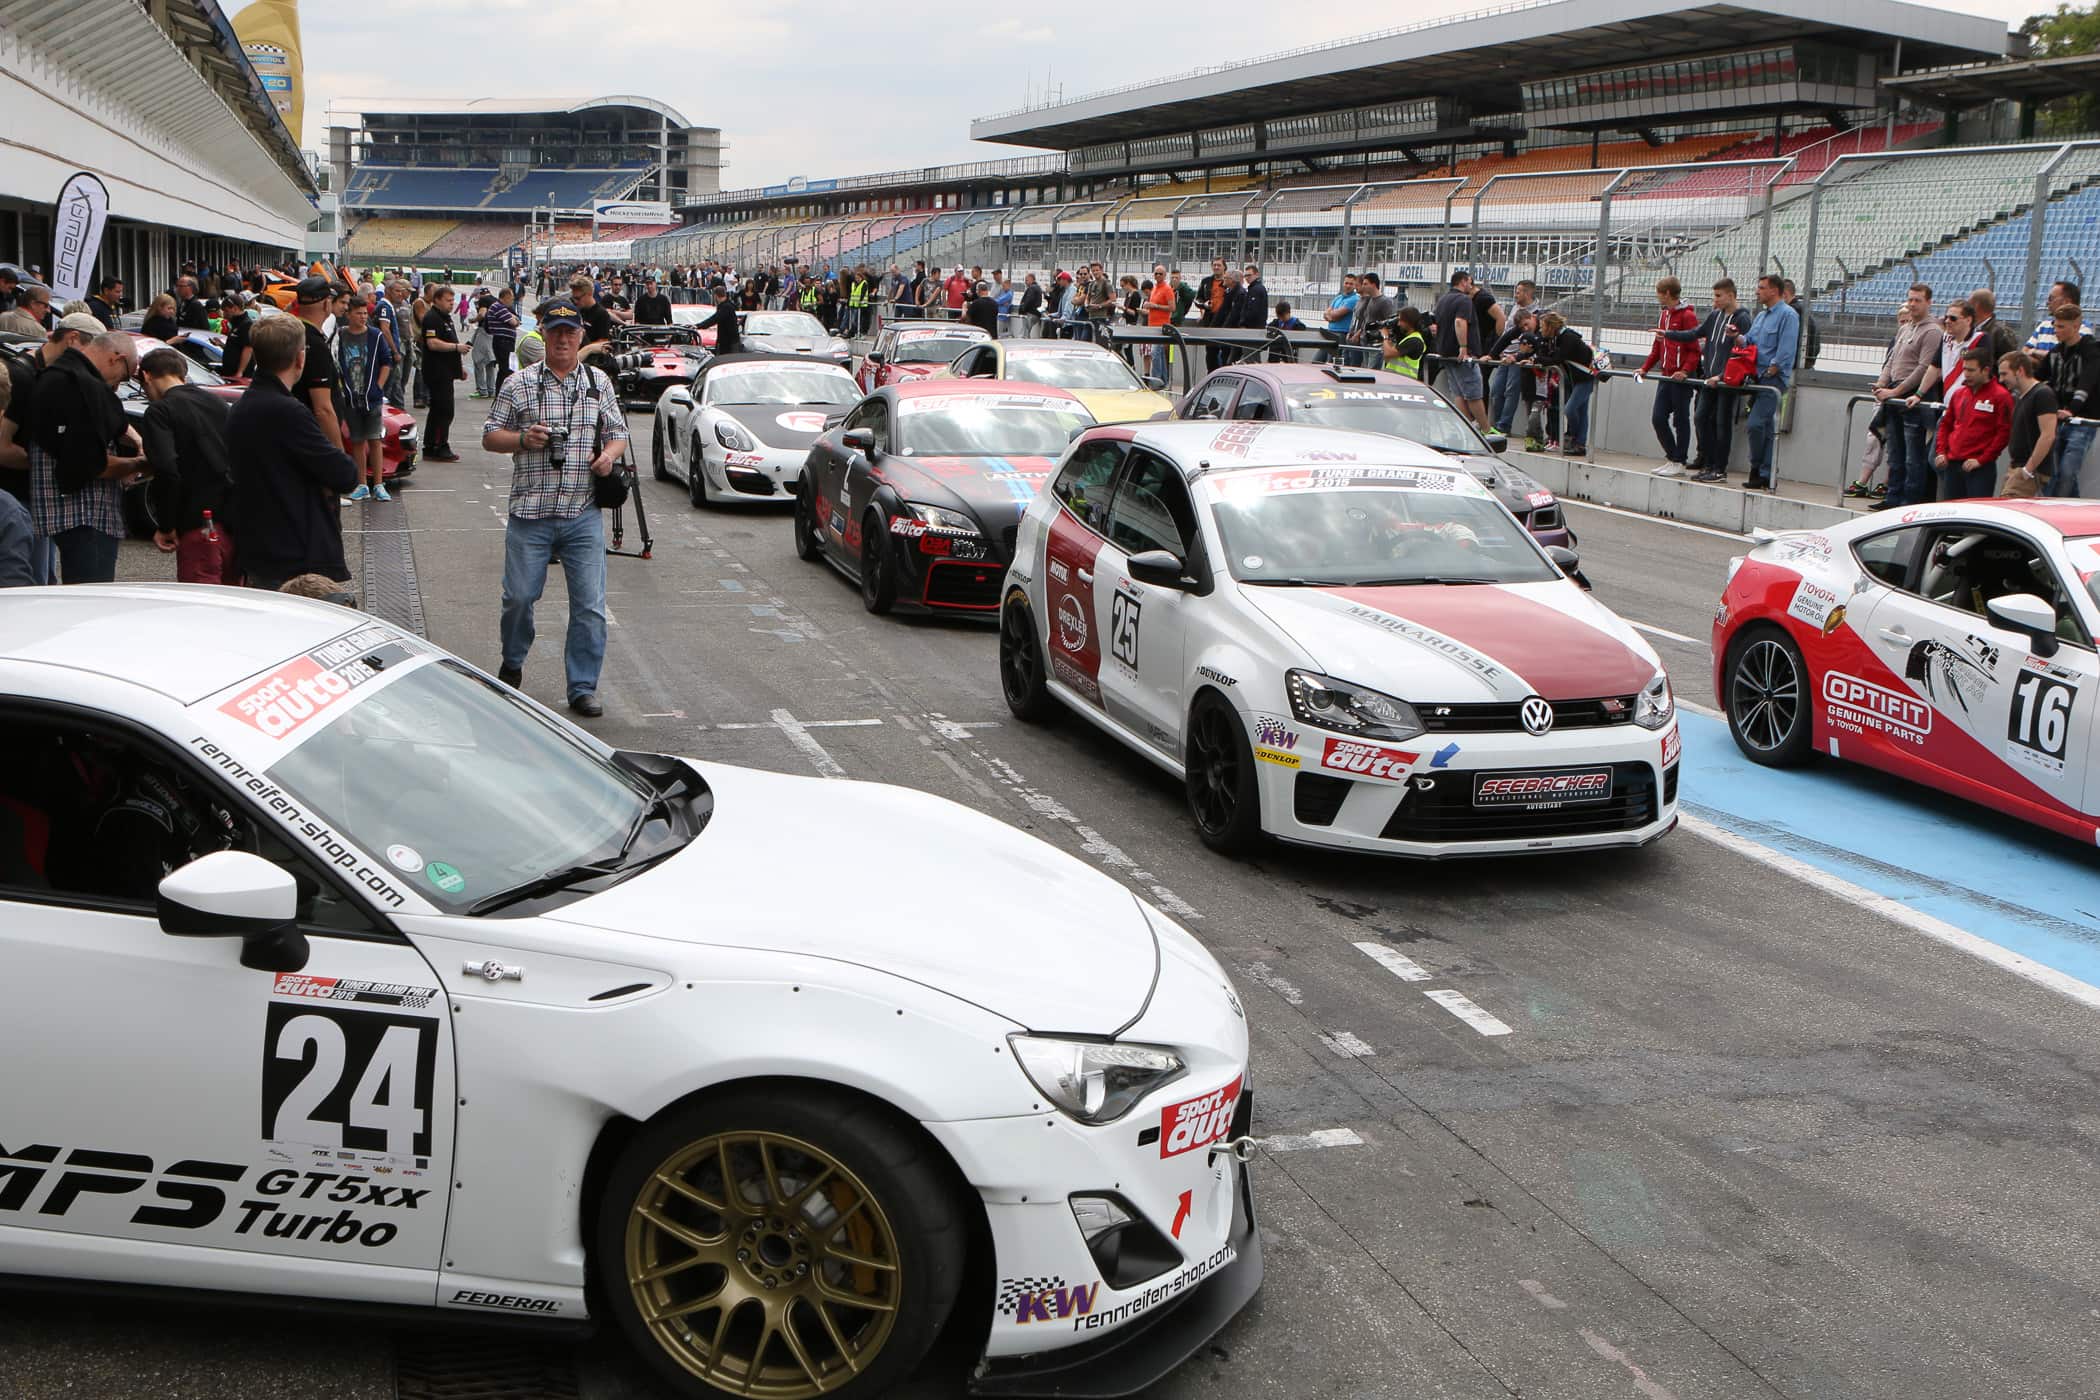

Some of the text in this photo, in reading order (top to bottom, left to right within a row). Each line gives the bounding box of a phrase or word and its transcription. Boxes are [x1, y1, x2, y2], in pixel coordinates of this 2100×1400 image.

[1399, 266, 1424, 280] HOTEL
[1315, 478, 1350, 487] 2015
[1318, 469, 1367, 478] TUNER
[1368, 470, 1416, 480] GRAND
[1416, 472, 1448, 482] PRIX
[890, 523, 925, 537] auto
[1011, 569, 1032, 585] DUNLOP
[1050, 560, 1069, 583] MOTUL
[1797, 595, 1824, 612] GENUINE
[1803, 582, 1836, 604] TOYOTA
[1058, 607, 1087, 638] DREXLER
[1793, 603, 1825, 624] MOTOR OIL
[1113, 595, 1139, 666] 25
[313, 639, 355, 668] TUNER
[339, 659, 377, 686] 2015
[1199, 666, 1239, 687] DUNLOP
[236, 675, 291, 717] sport
[256, 670, 350, 737] auto
[1829, 679, 1924, 725] OPTIFIT
[1435, 706, 1451, 716] R
[2018, 677, 2070, 753] 16
[1827, 705, 1924, 745] GENUINE PARTS
[1827, 716, 1863, 736] by TOYOTA
[1260, 726, 1300, 750] KW
[1333, 741, 1383, 758] sport
[1259, 751, 1300, 765] DUNLOP
[1326, 752, 1414, 779] auto
[1479, 774, 1608, 796] SEEBACHER
[190, 736, 407, 908] rennreifen-shop.com
[274, 979, 433, 998] auto TUNER GRAND PRIX
[279, 975, 313, 985] sport
[332, 989, 358, 1001] 2015
[274, 1014, 424, 1153] 24
[1174, 1088, 1225, 1123] sport
[255, 1168, 433, 1209] GT5xx
[234, 1199, 398, 1247] Turbo
[1073, 1245, 1236, 1332] rennreifen-shop.com
[452, 1290, 560, 1311] FEDERAL
[1015, 1279, 1102, 1325] KW
